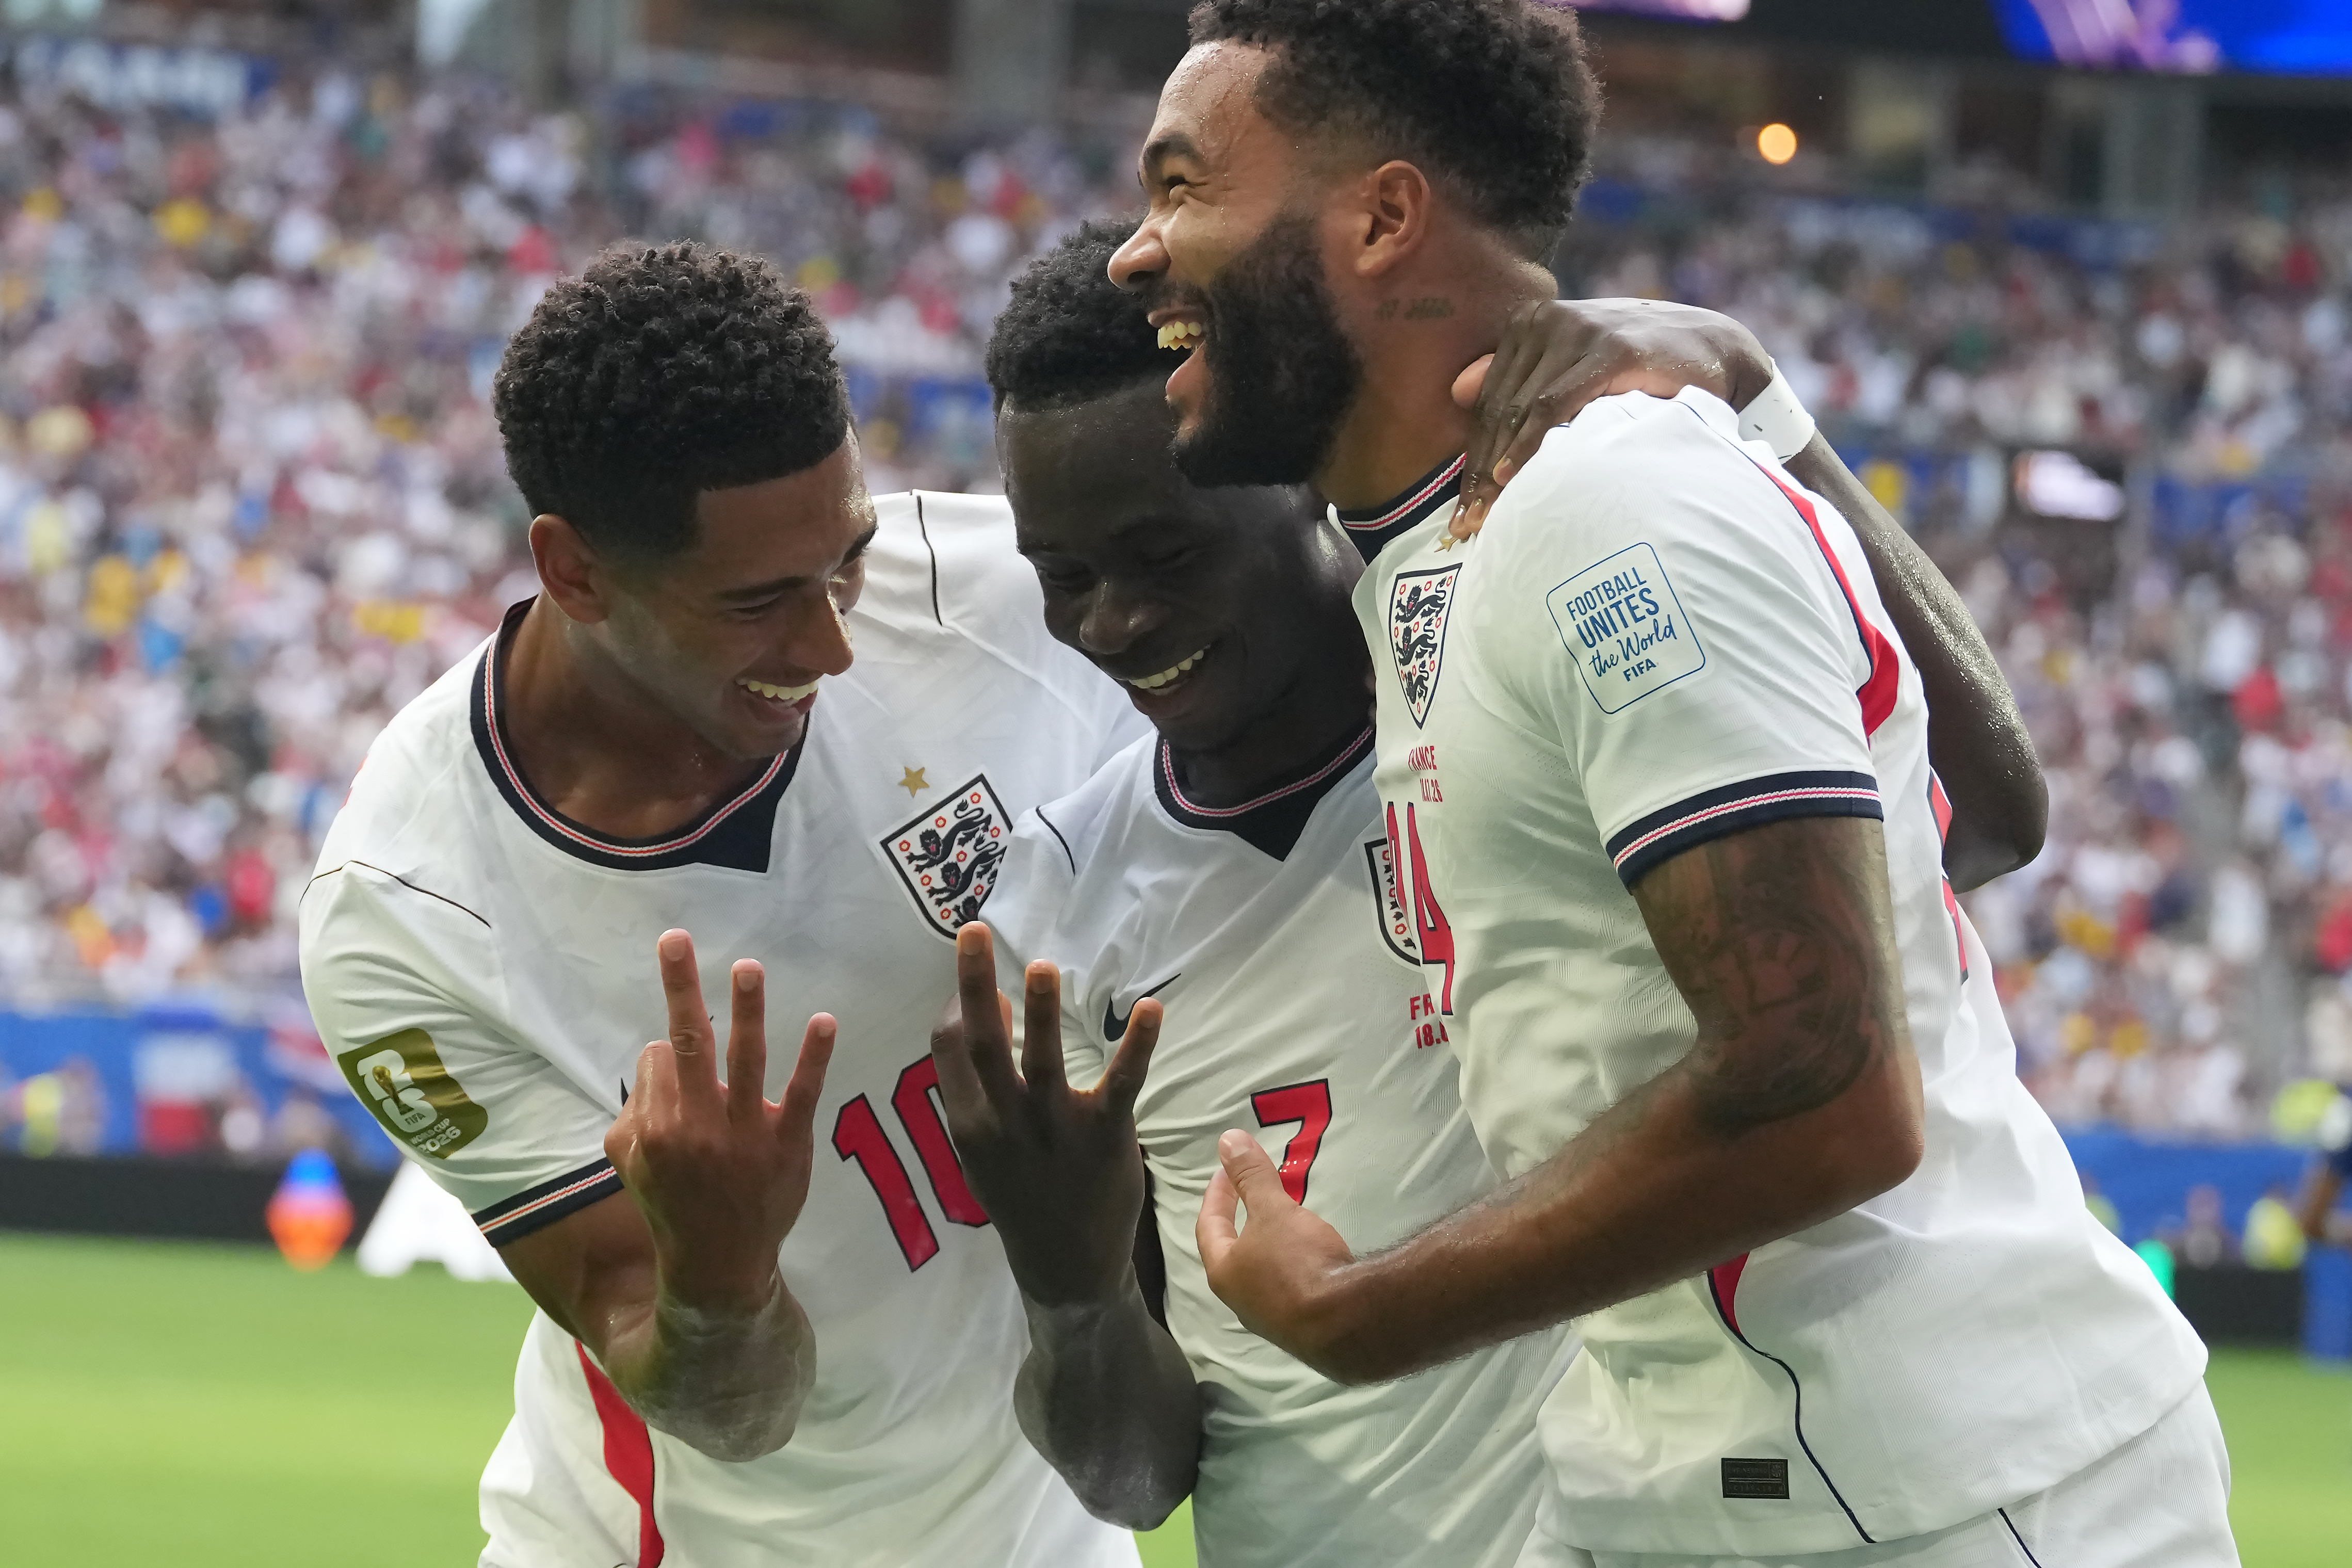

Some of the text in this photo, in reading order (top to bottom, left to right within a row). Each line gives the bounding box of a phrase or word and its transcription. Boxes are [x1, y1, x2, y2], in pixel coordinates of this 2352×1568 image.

[1566, 567, 1647, 621] FOOTBALL
[1575, 587, 1660, 649] UNITES
[1589, 614, 1677, 677] the World
[1622, 658, 1657, 682] FIFA
[831, 1053, 991, 1272] 10
[1251, 1078, 1332, 1206] 7
